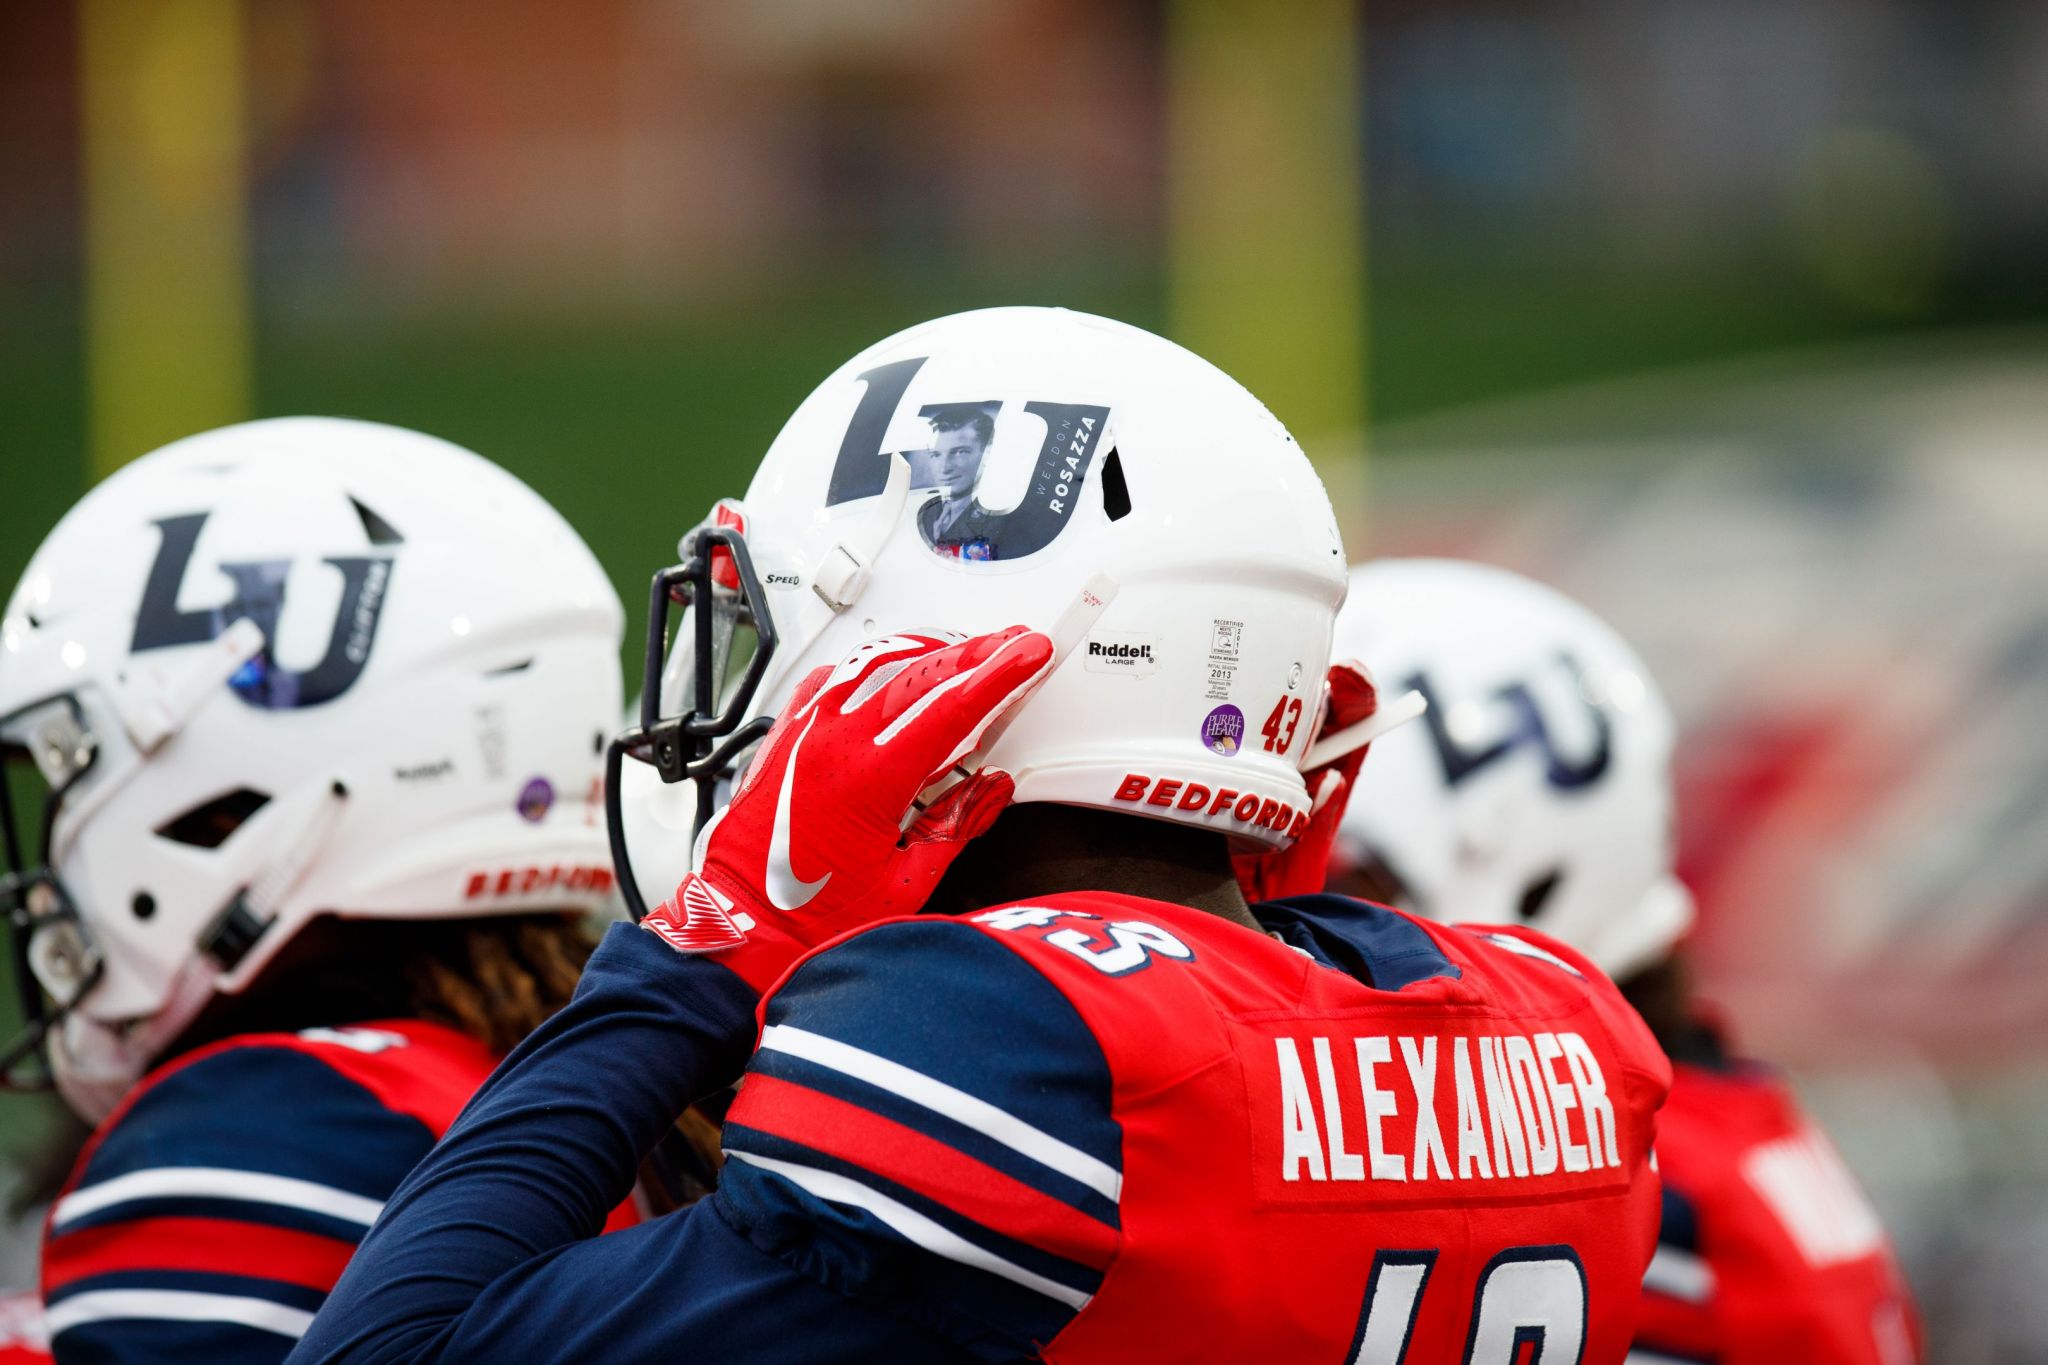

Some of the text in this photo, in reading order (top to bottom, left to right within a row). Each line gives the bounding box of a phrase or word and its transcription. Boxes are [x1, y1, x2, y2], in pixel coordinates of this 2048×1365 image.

[1036, 418, 1072, 496] WELDON
[1048, 416, 1097, 515] ROSAZZA
[1105, 658, 1135, 666] LARGE
[1211, 669, 1232, 679] 2013
[1206, 724, 1242, 737] HEART
[1208, 714, 1243, 726] PURPLE
[1261, 694, 1303, 755] 43
[1274, 1032, 1622, 1184] ALEXANDER
